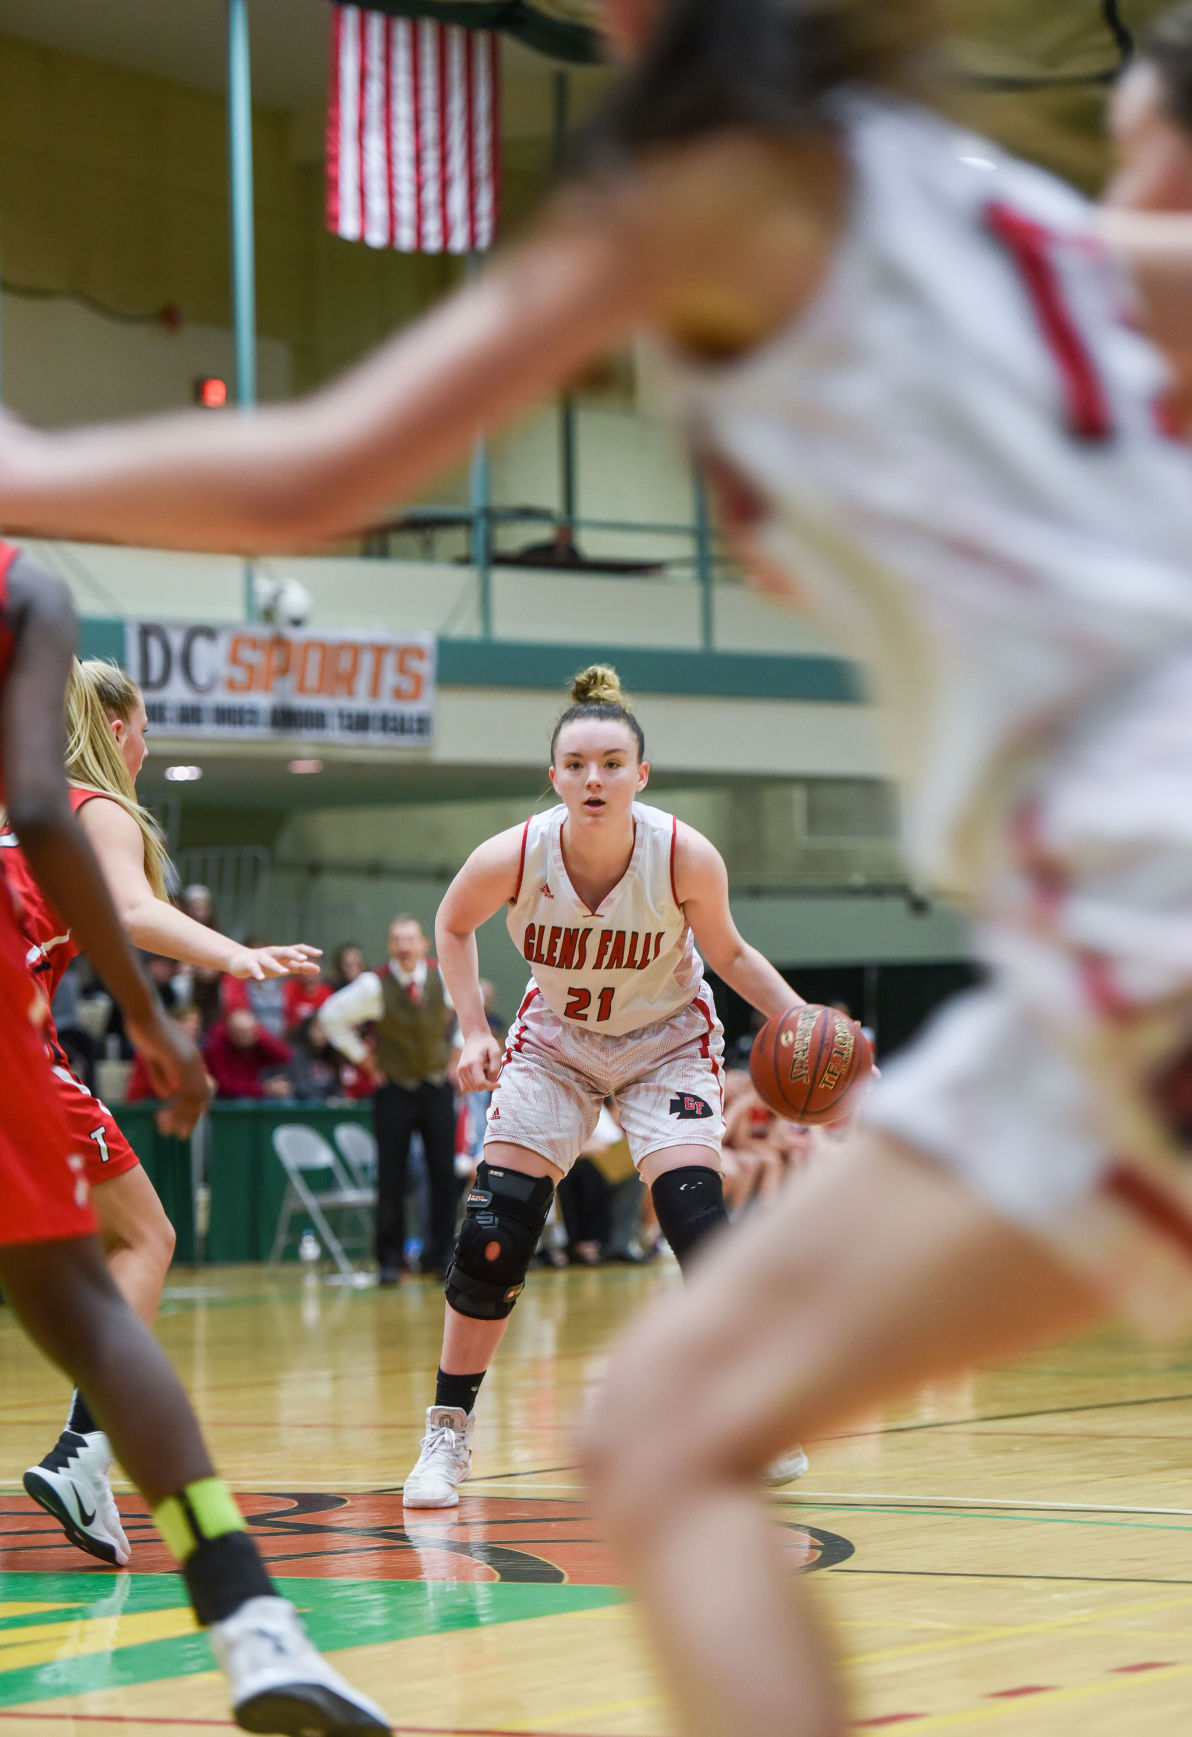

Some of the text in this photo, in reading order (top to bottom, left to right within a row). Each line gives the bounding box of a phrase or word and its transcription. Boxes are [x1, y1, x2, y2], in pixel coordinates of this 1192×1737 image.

[137, 622, 427, 702] DC SPORTS
[523, 922, 666, 970] GLENS FALLS
[563, 986, 616, 1022] 21
[684, 1096, 704, 1115] GF
[90, 1126, 110, 1163] T
